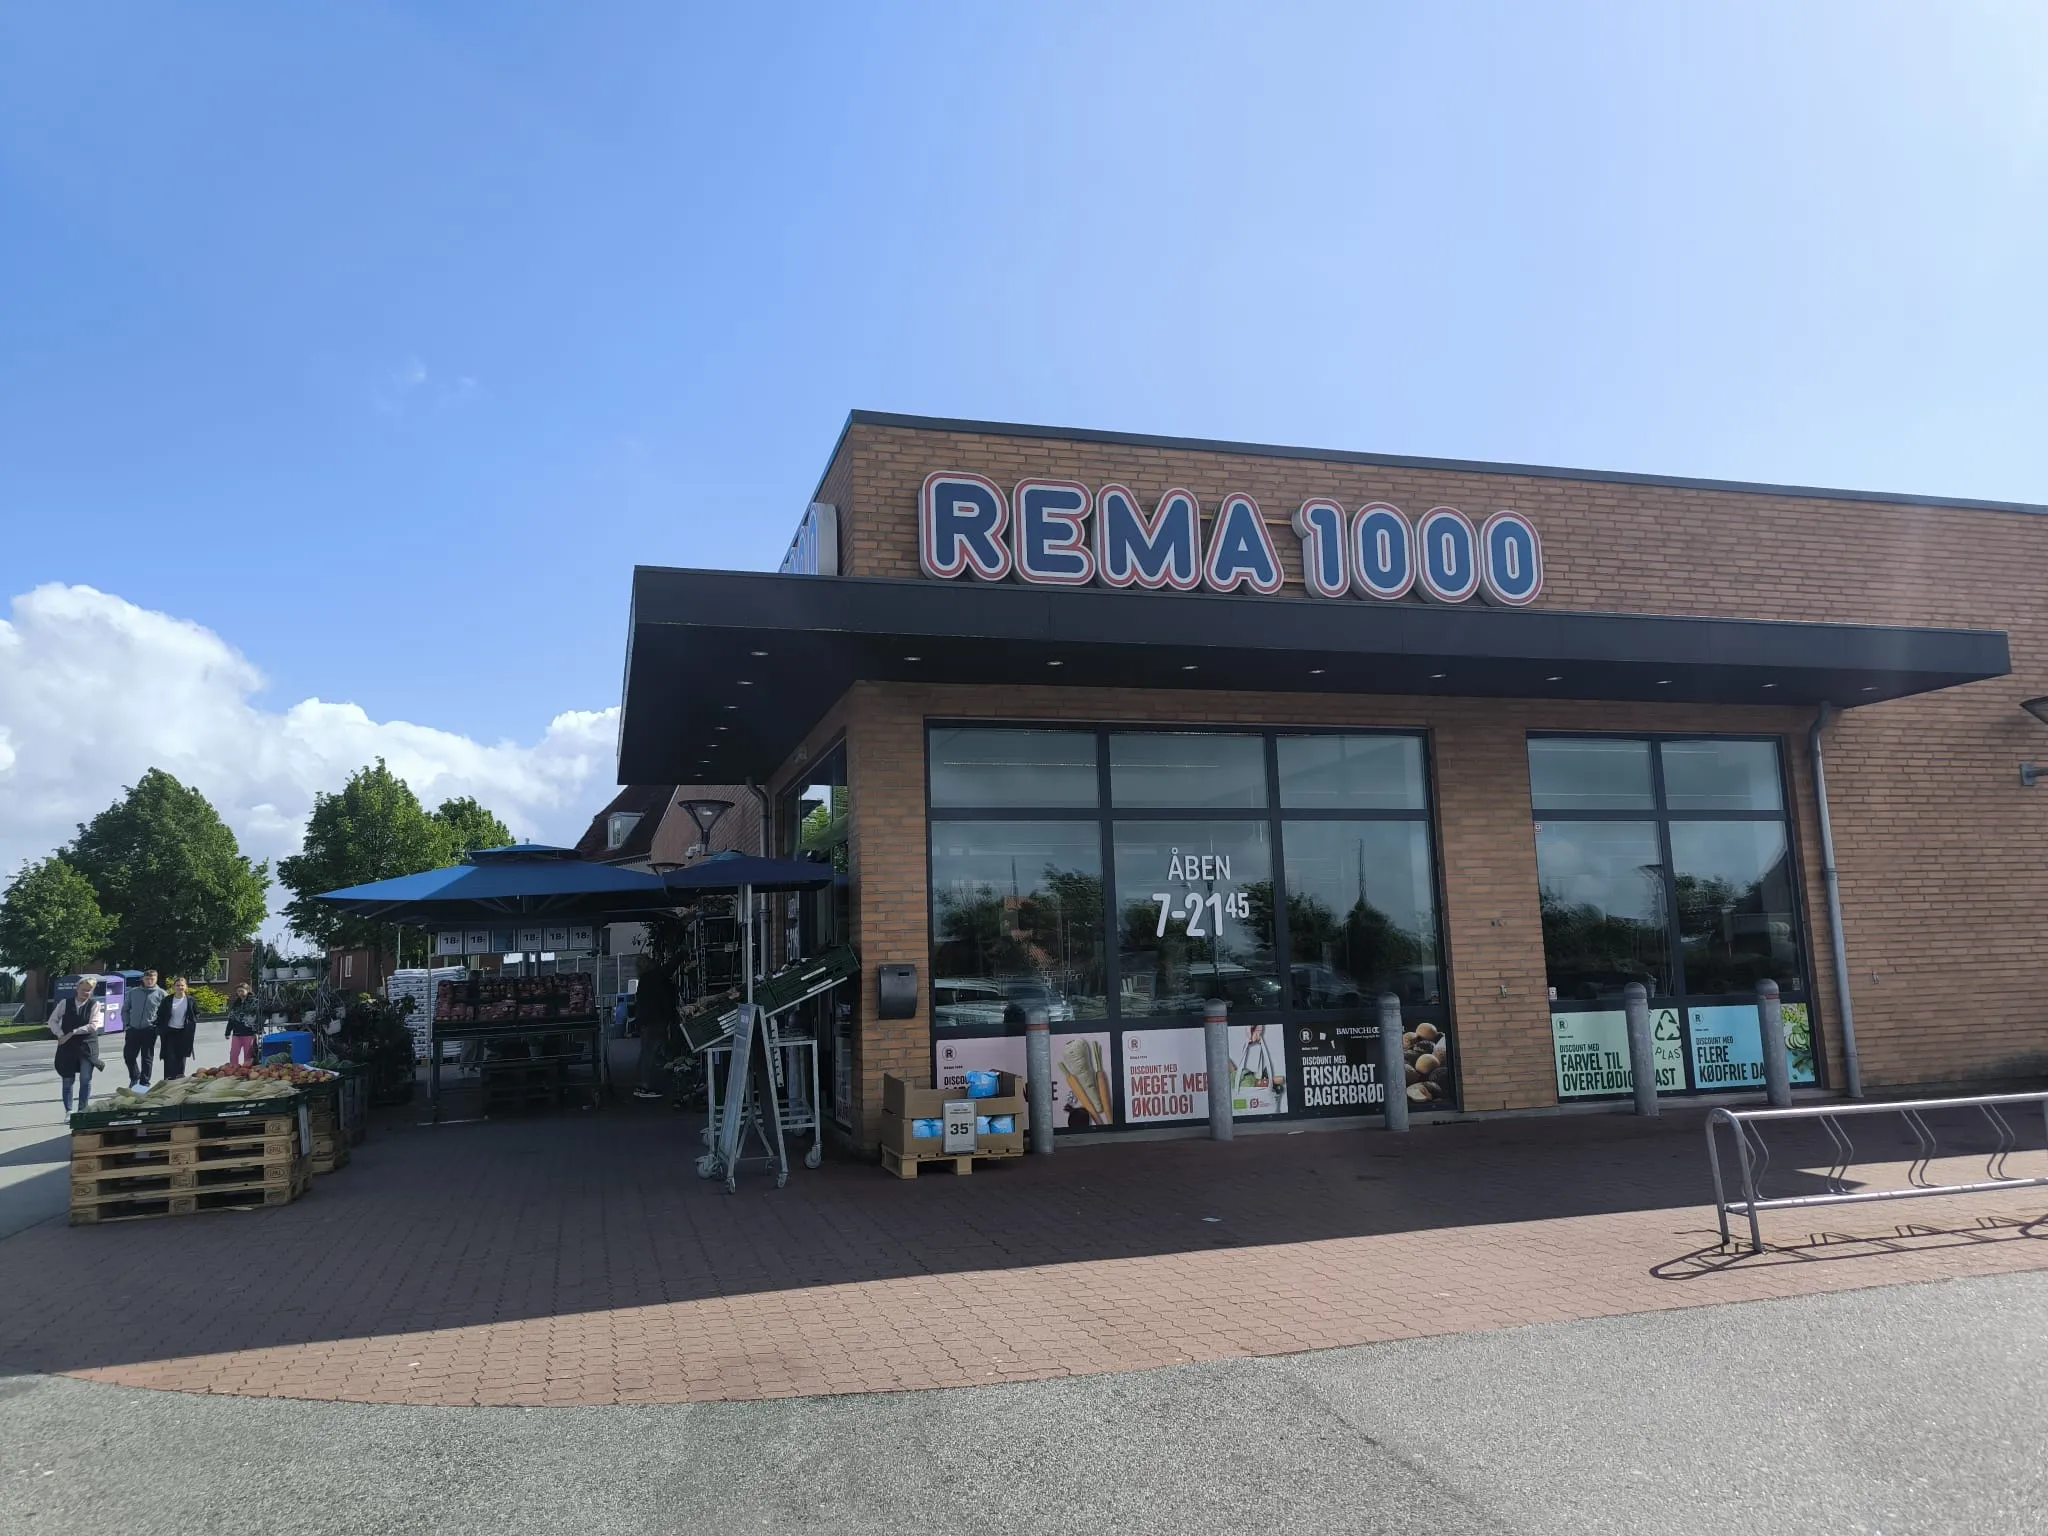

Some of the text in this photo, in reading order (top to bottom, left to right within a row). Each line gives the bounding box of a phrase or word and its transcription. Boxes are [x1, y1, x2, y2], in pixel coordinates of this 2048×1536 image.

[919, 470, 1285, 595] REMA
[1292, 497, 1545, 607] 1000
[1168, 847, 1231, 881] ÅBEN
[1560, 1043, 1600, 1053] DISCOUNT MED
[1696, 1036, 1734, 1045] DISCOUNT MED
[1302, 1055, 1347, 1065] DISCOUNT MED
[1561, 1052, 1623, 1072] FARVEL TIL
[1655, 1046, 1681, 1060] PLAS
[1697, 1045, 1730, 1063] FLERE
[1130, 1064, 1178, 1074] DISCOUNT MED
[1303, 1064, 1376, 1086] FRISKBAGT
[1655, 1068, 1676, 1086] AST
[1699, 1063, 1748, 1082] KØDFRIE
[1131, 1074, 1178, 1096] MEGET
[1304, 1083, 1384, 1106] BAGERBRØD
[1131, 1094, 1194, 1118] ØKOLOGI
